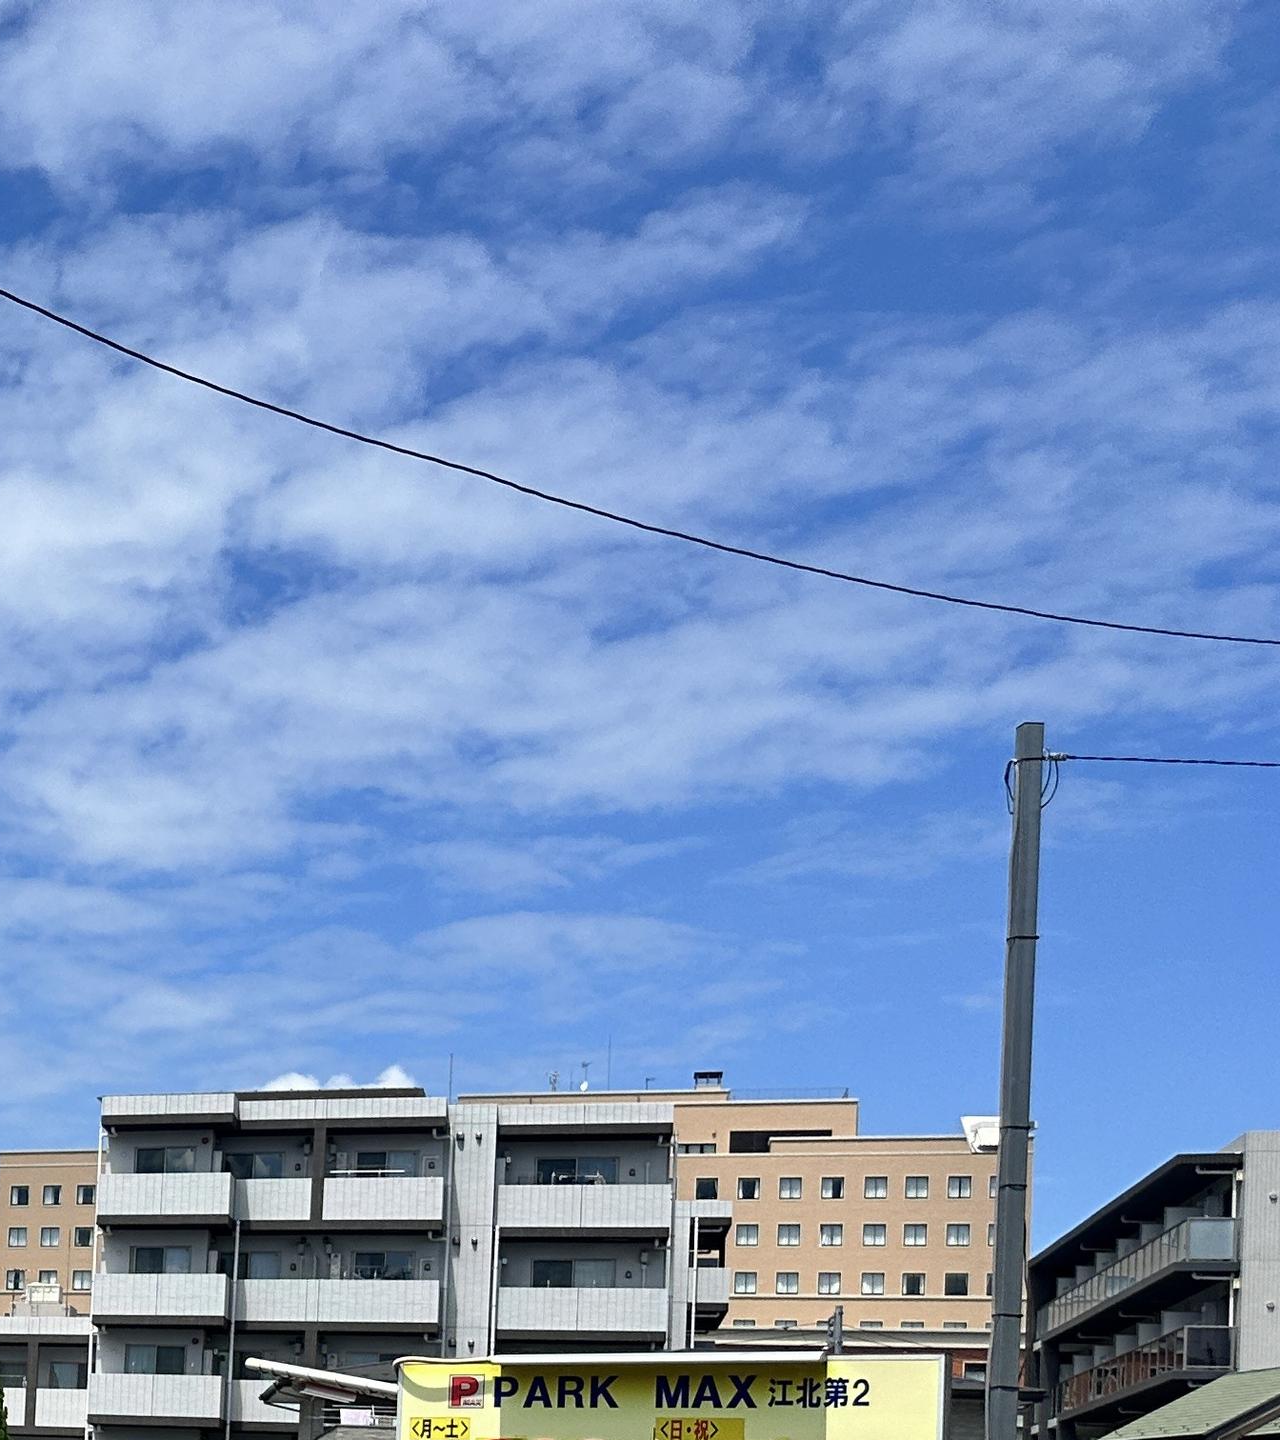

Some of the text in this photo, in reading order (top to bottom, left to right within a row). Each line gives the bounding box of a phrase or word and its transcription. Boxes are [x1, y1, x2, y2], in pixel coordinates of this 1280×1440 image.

[493, 1375, 870, 1409] PARK MAX 江北第2
